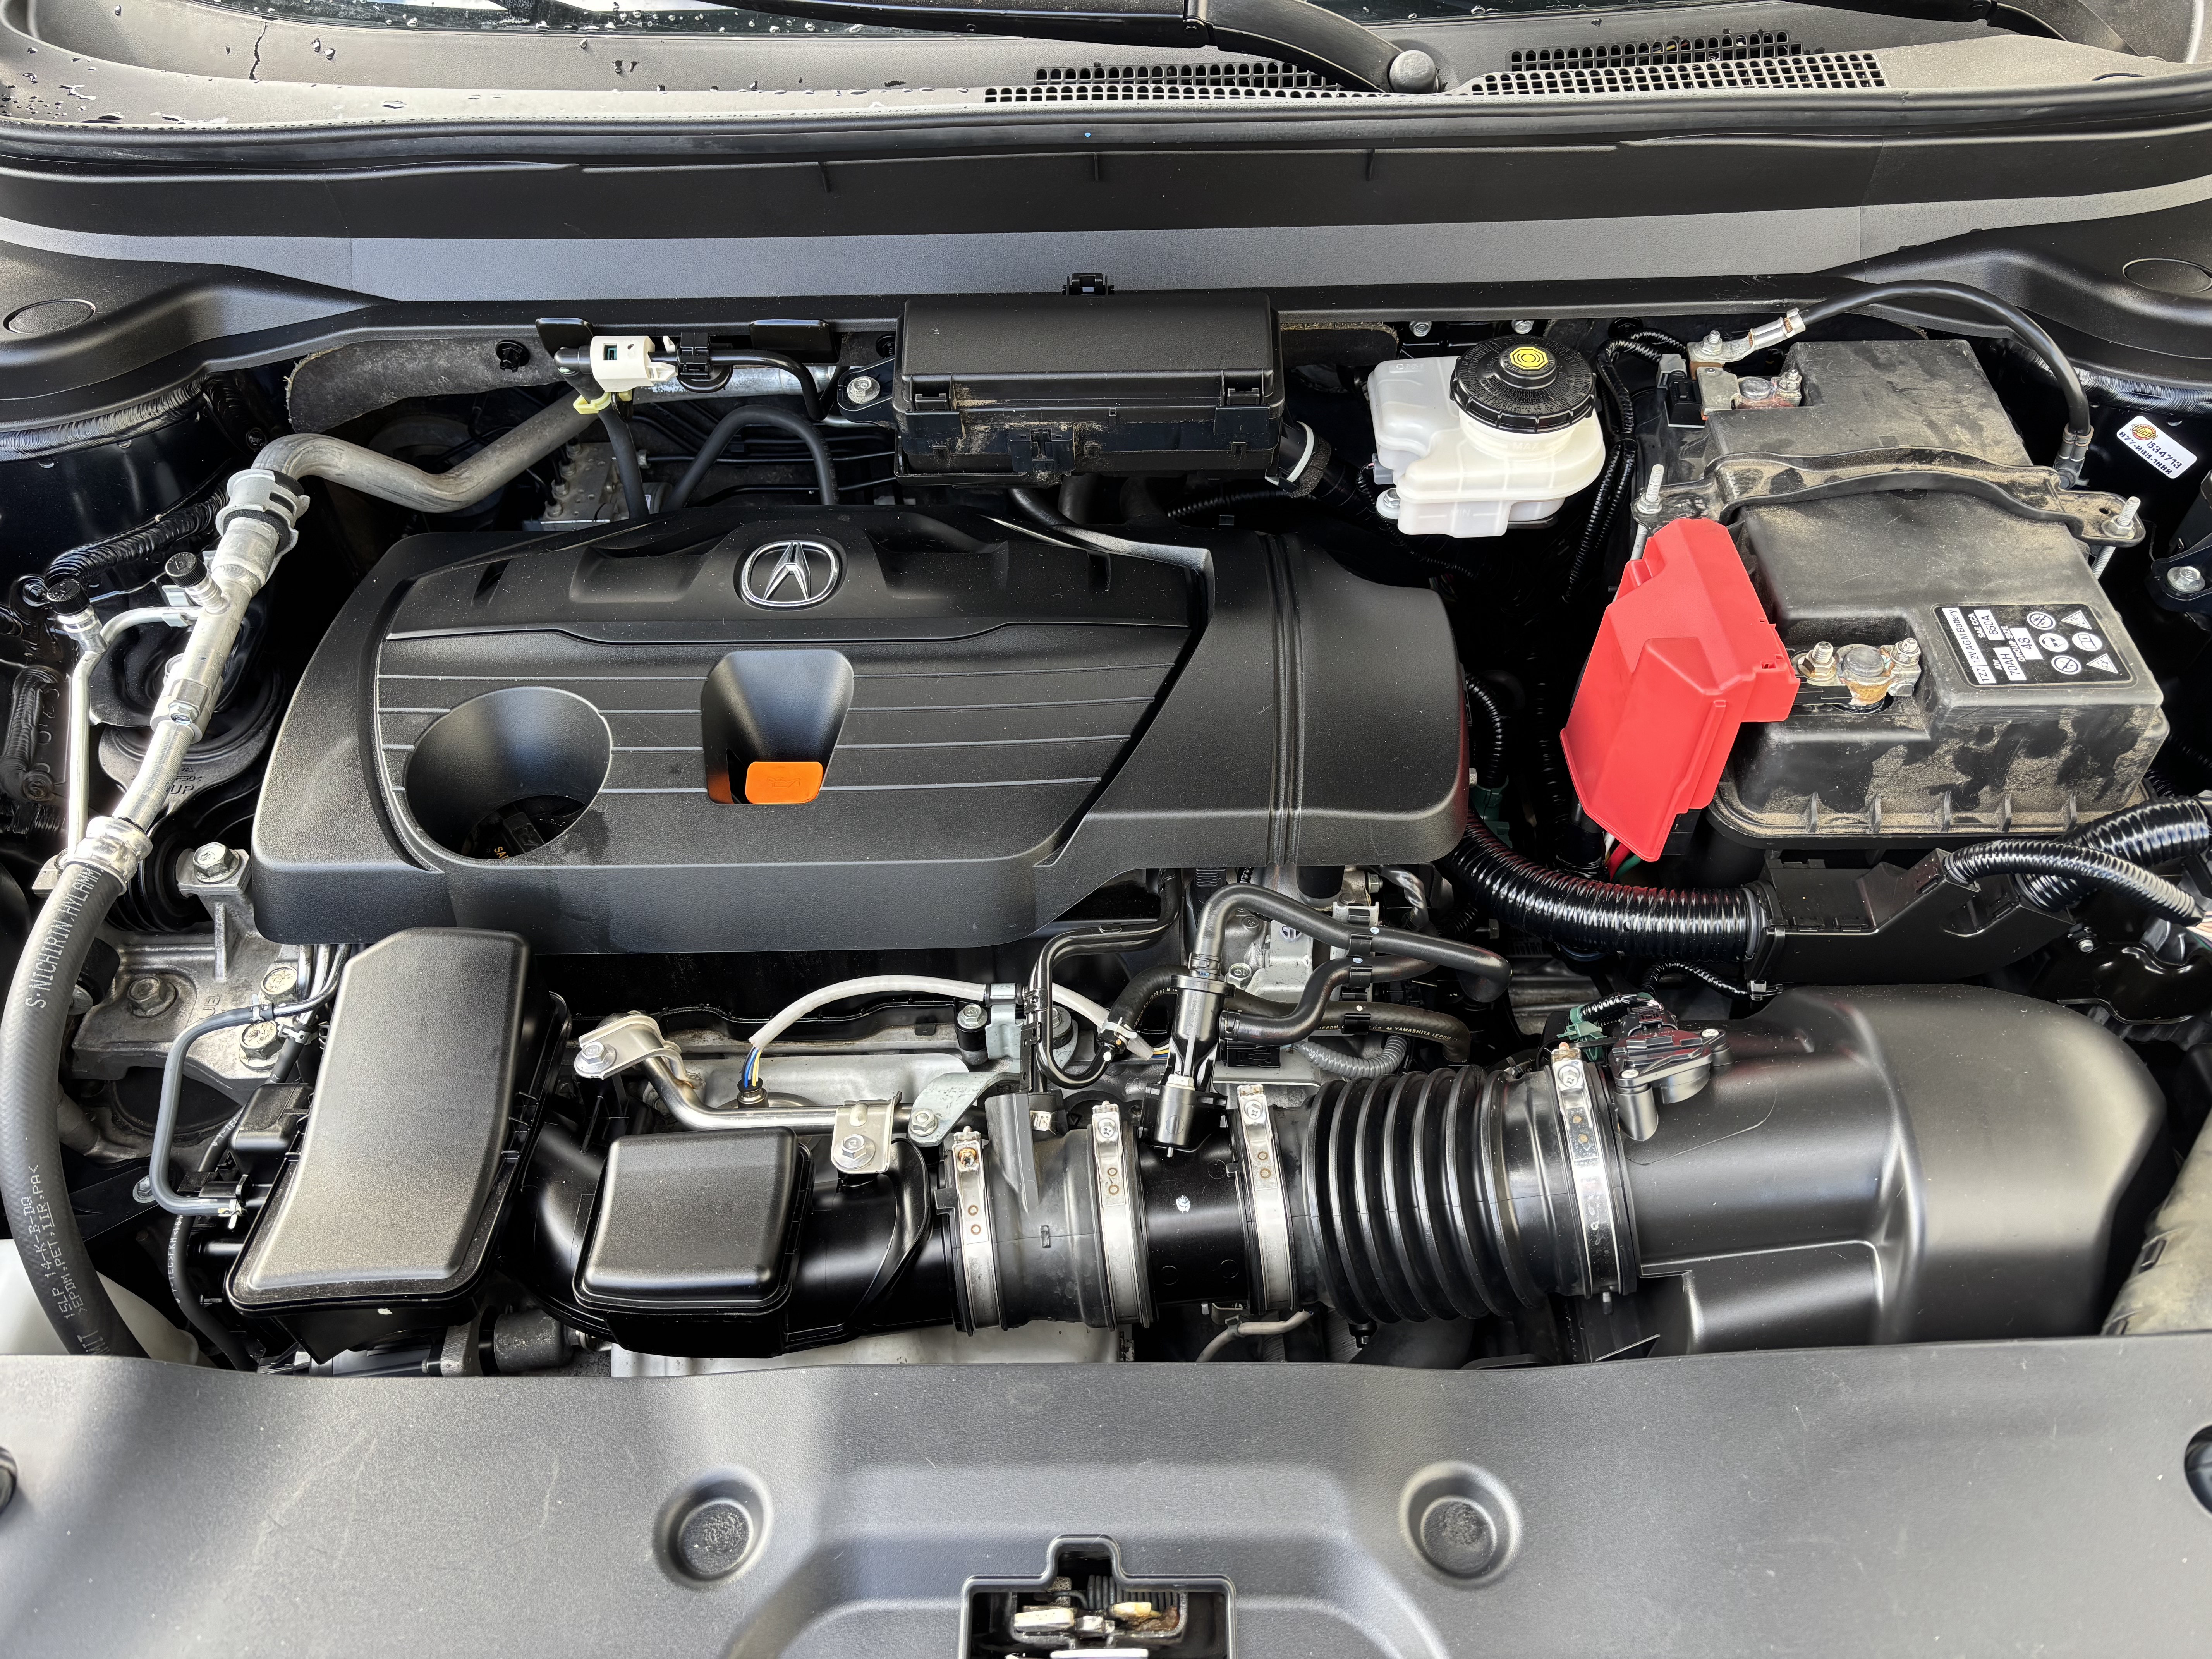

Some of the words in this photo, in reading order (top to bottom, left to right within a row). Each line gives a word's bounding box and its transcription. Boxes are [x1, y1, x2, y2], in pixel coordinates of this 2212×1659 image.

[1949, 610, 1965, 633] Battery
[1968, 613, 1979, 626] CCA
[1981, 615, 1999, 635] 650A
[1974, 626, 1986, 638] SAE
[2001, 625, 2013, 639] SIZE
[1959, 634, 1974, 650] AGM
[2018, 638, 2032, 649] 48
[1968, 651, 1980, 663] 12V
[2008, 640, 2026, 662] GROUP
[2000, 654, 2020, 675] 70AH
[1976, 668, 1990, 682] TZ7
[1395, 1026, 1430, 1036] YAMASHITA
